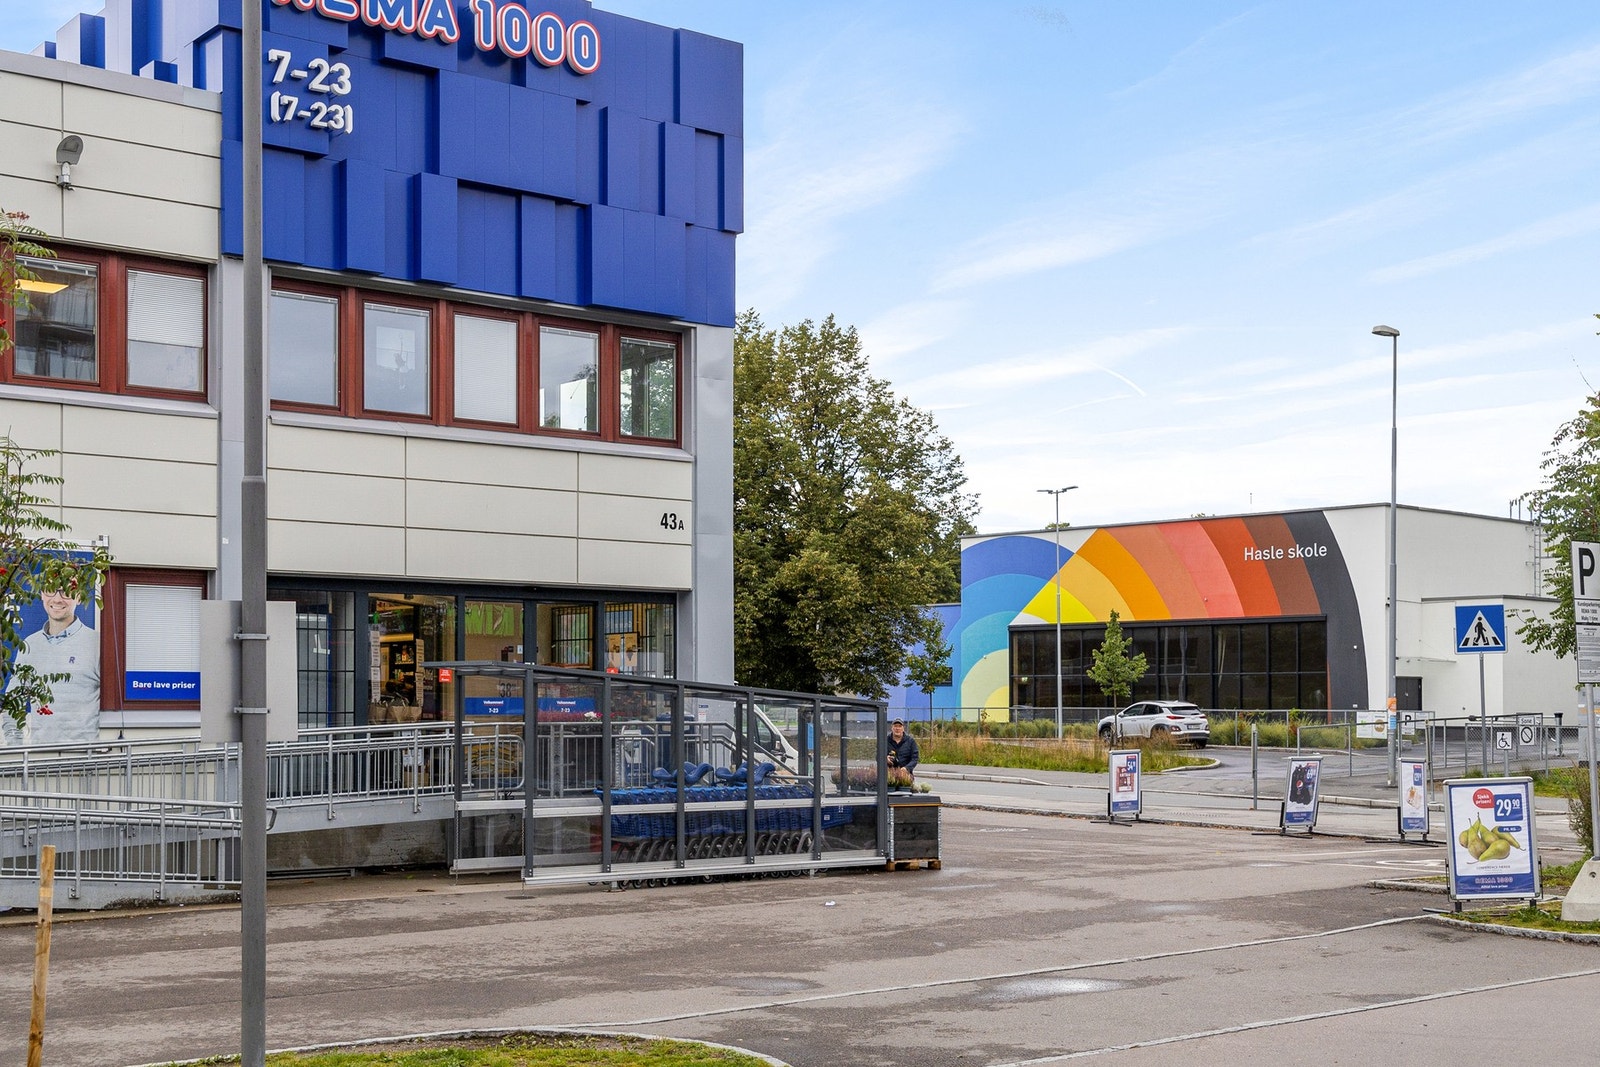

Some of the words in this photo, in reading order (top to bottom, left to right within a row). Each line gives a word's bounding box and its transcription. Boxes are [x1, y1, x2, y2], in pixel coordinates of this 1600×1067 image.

[271, 0, 460, 43] MA
[470, 0, 601, 74] 1000
[268, 49, 352, 95] 7-23
[270, 90, 354, 134] (7-23)
[1244, 545, 1284, 561] Hasle
[1287, 542, 1328, 559] skole
[1578, 547, 1595, 596] P
[68, 656, 76, 664] R
[132, 680, 152, 689] Bare
[153, 681, 171, 689] lave
[172, 681, 196, 690] priser
[1405, 714, 1411, 726] P
